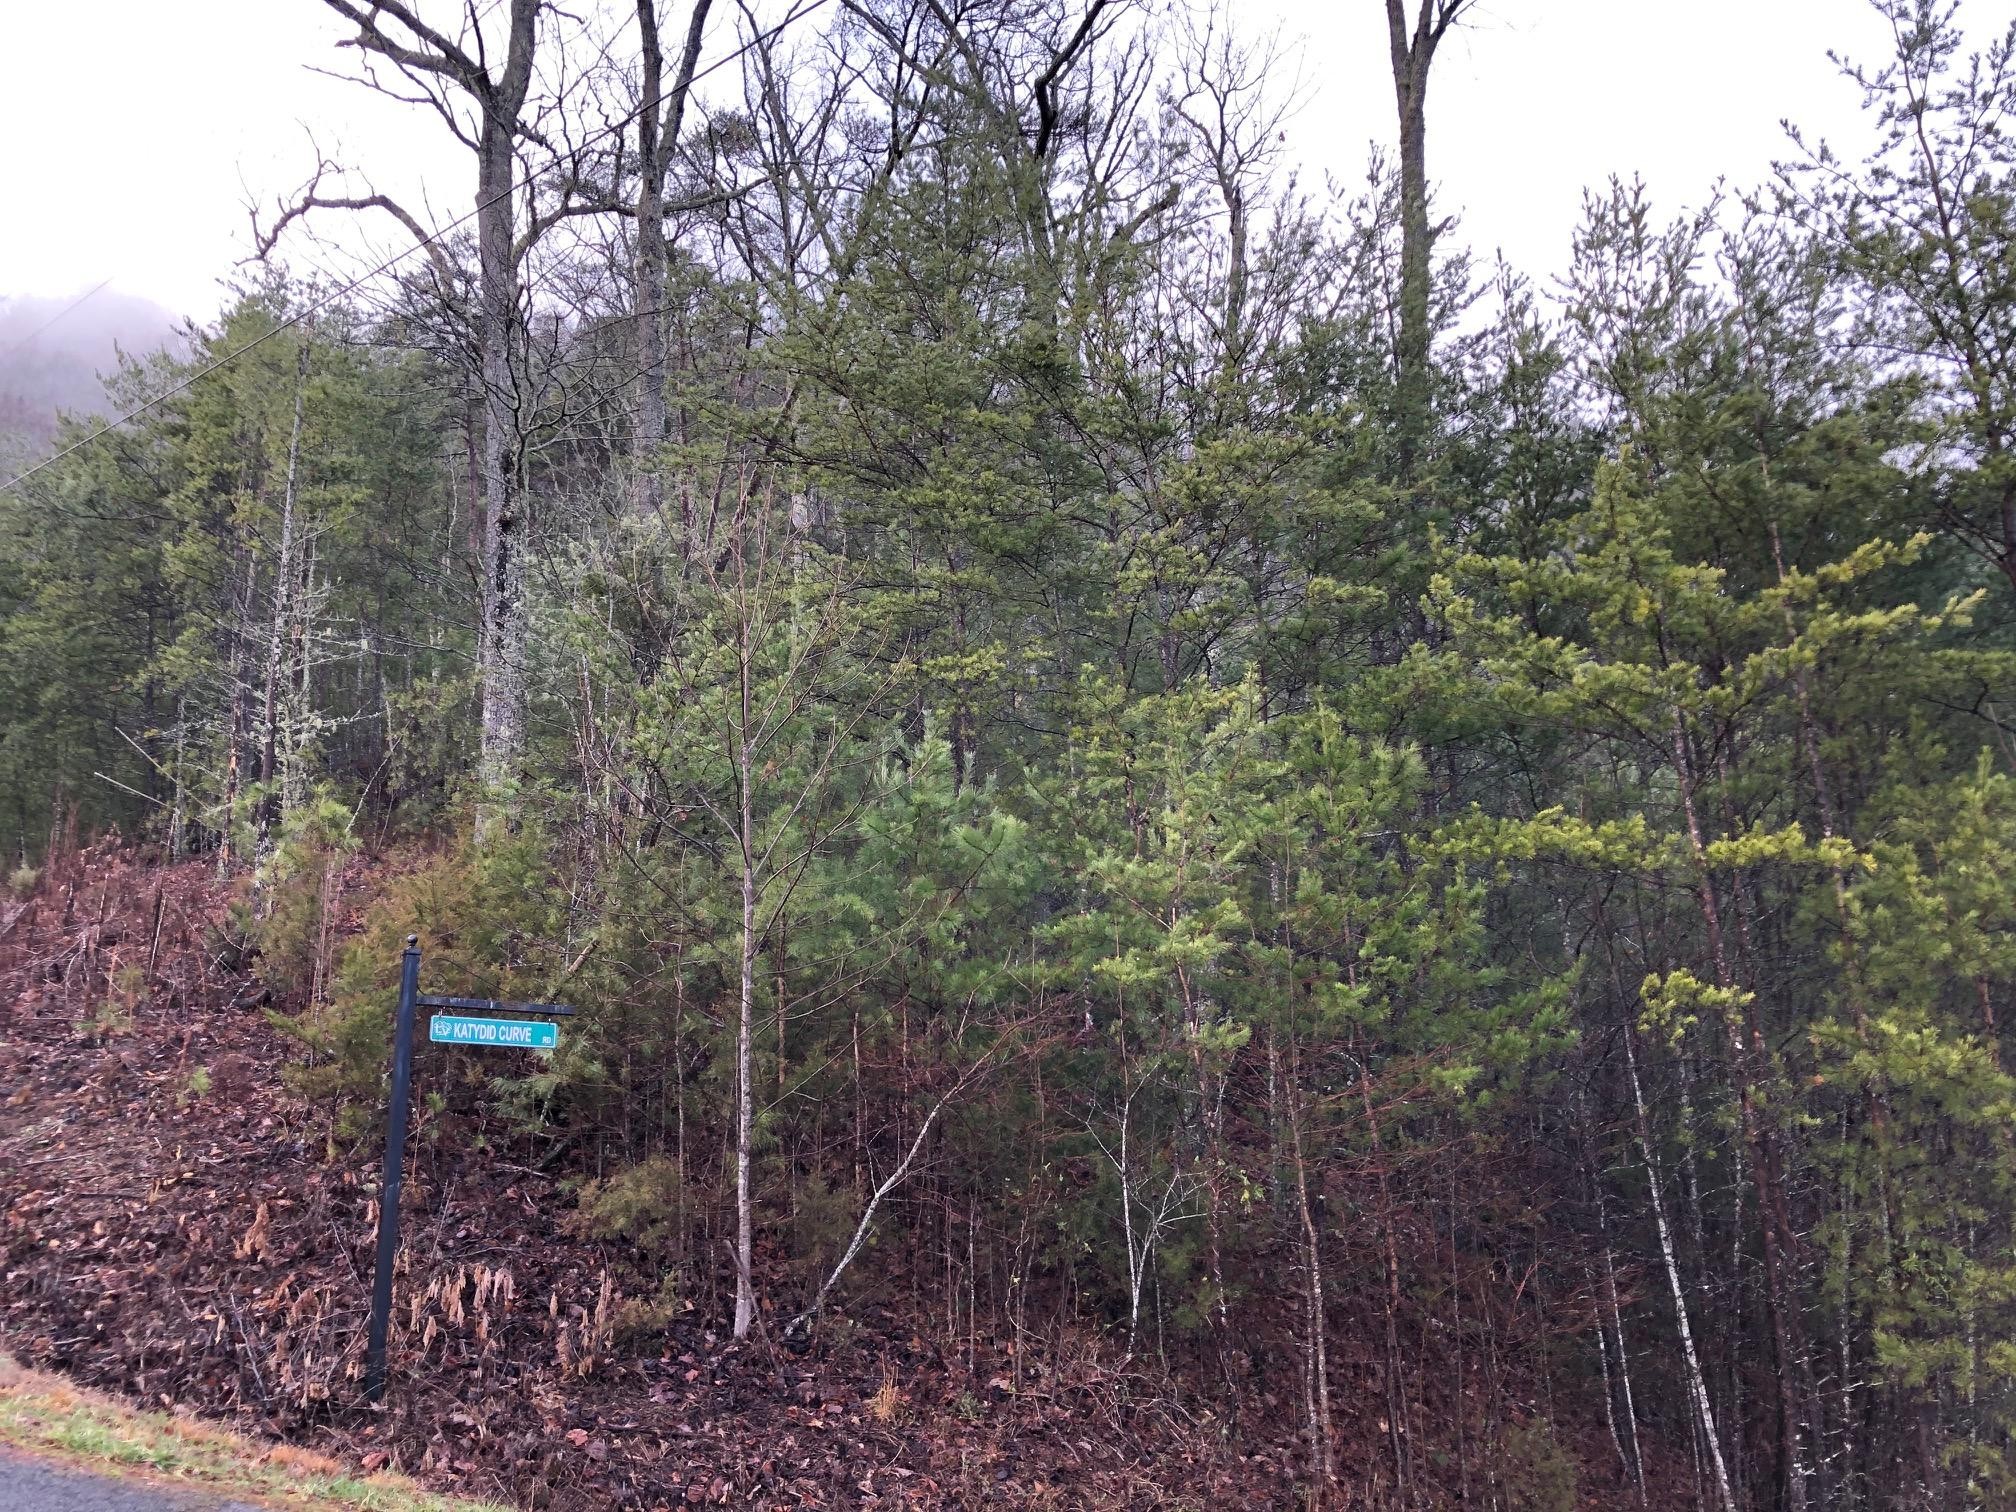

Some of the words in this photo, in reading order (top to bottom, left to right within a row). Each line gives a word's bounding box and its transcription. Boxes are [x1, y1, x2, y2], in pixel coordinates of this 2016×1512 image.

[453, 1022, 496, 1040] KATYDID
[499, 1026, 532, 1042] CURVE
[542, 1036, 552, 1044] RD
